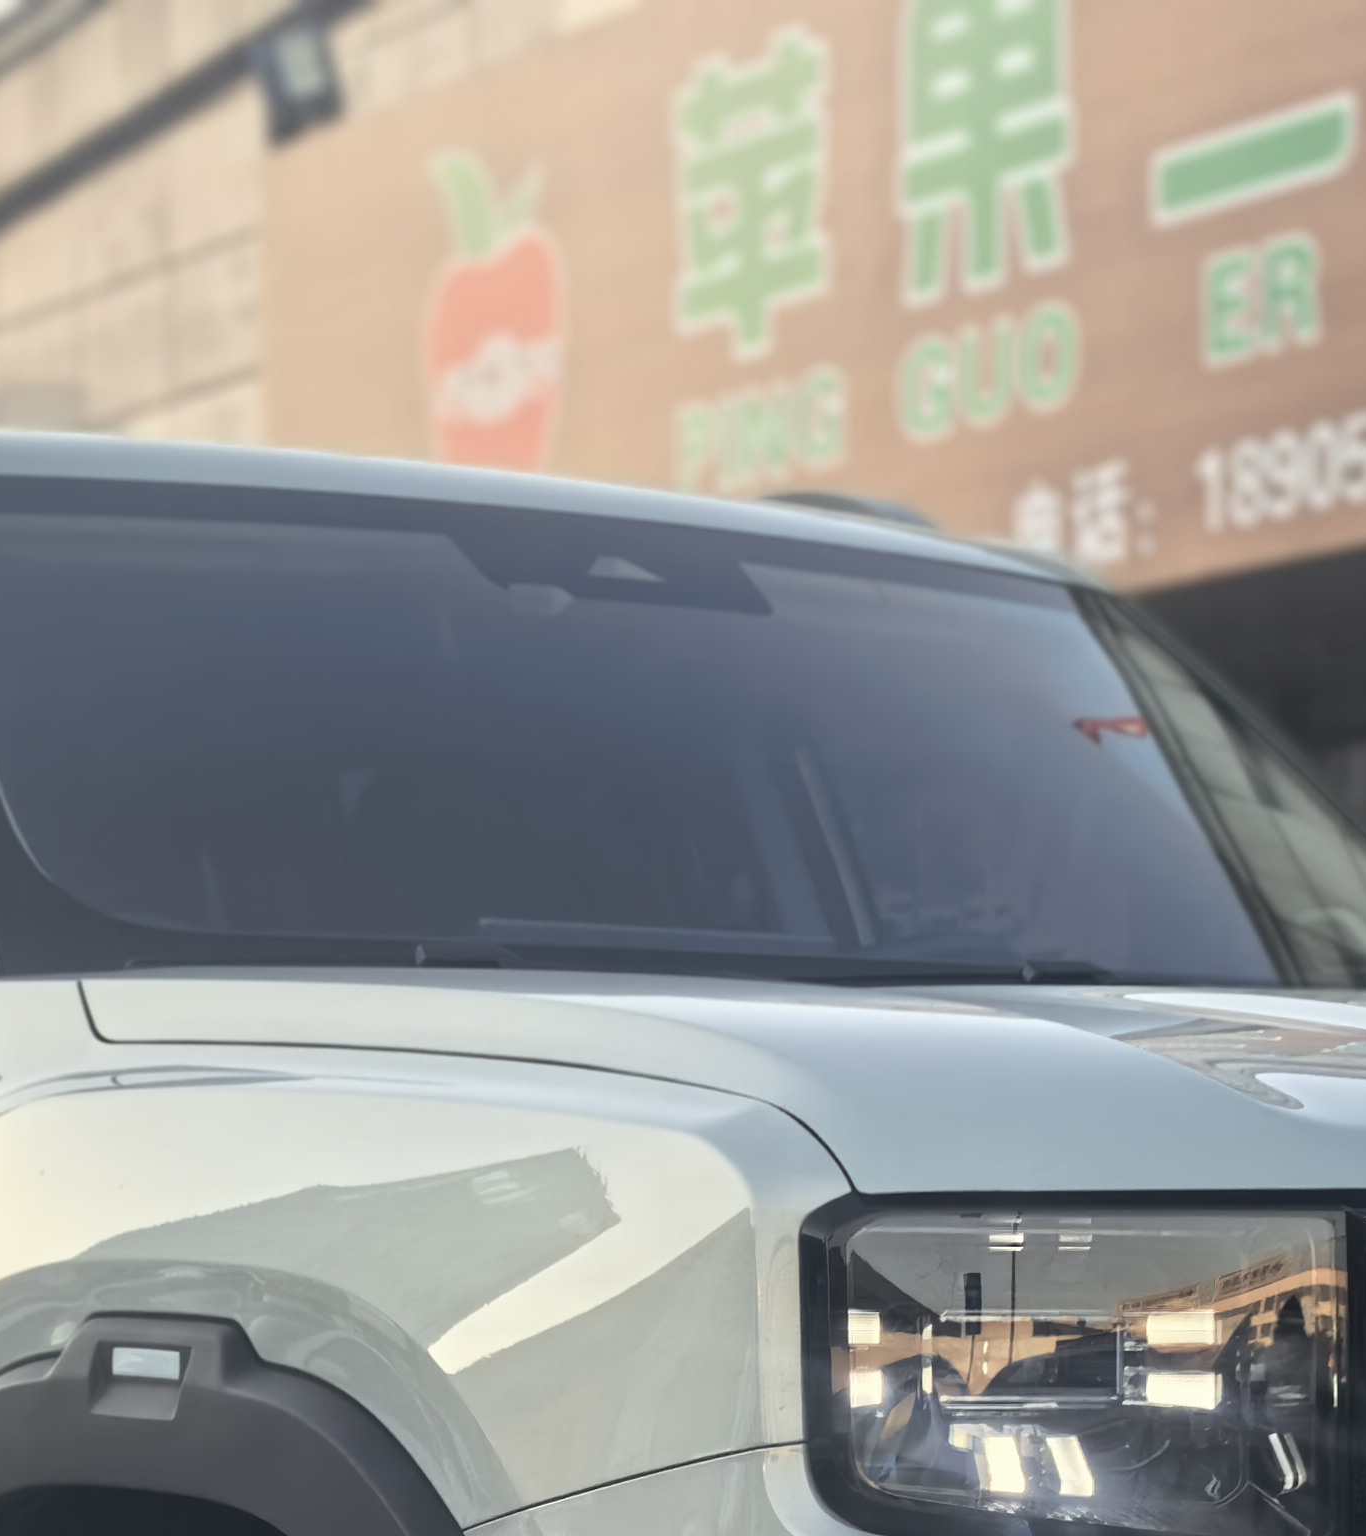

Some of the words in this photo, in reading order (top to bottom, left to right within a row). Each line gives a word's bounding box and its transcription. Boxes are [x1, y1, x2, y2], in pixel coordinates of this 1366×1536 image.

[673, 364, 845, 492] PING
[897, 301, 1081, 444] GUO
[1201, 229, 1322, 368] ER
